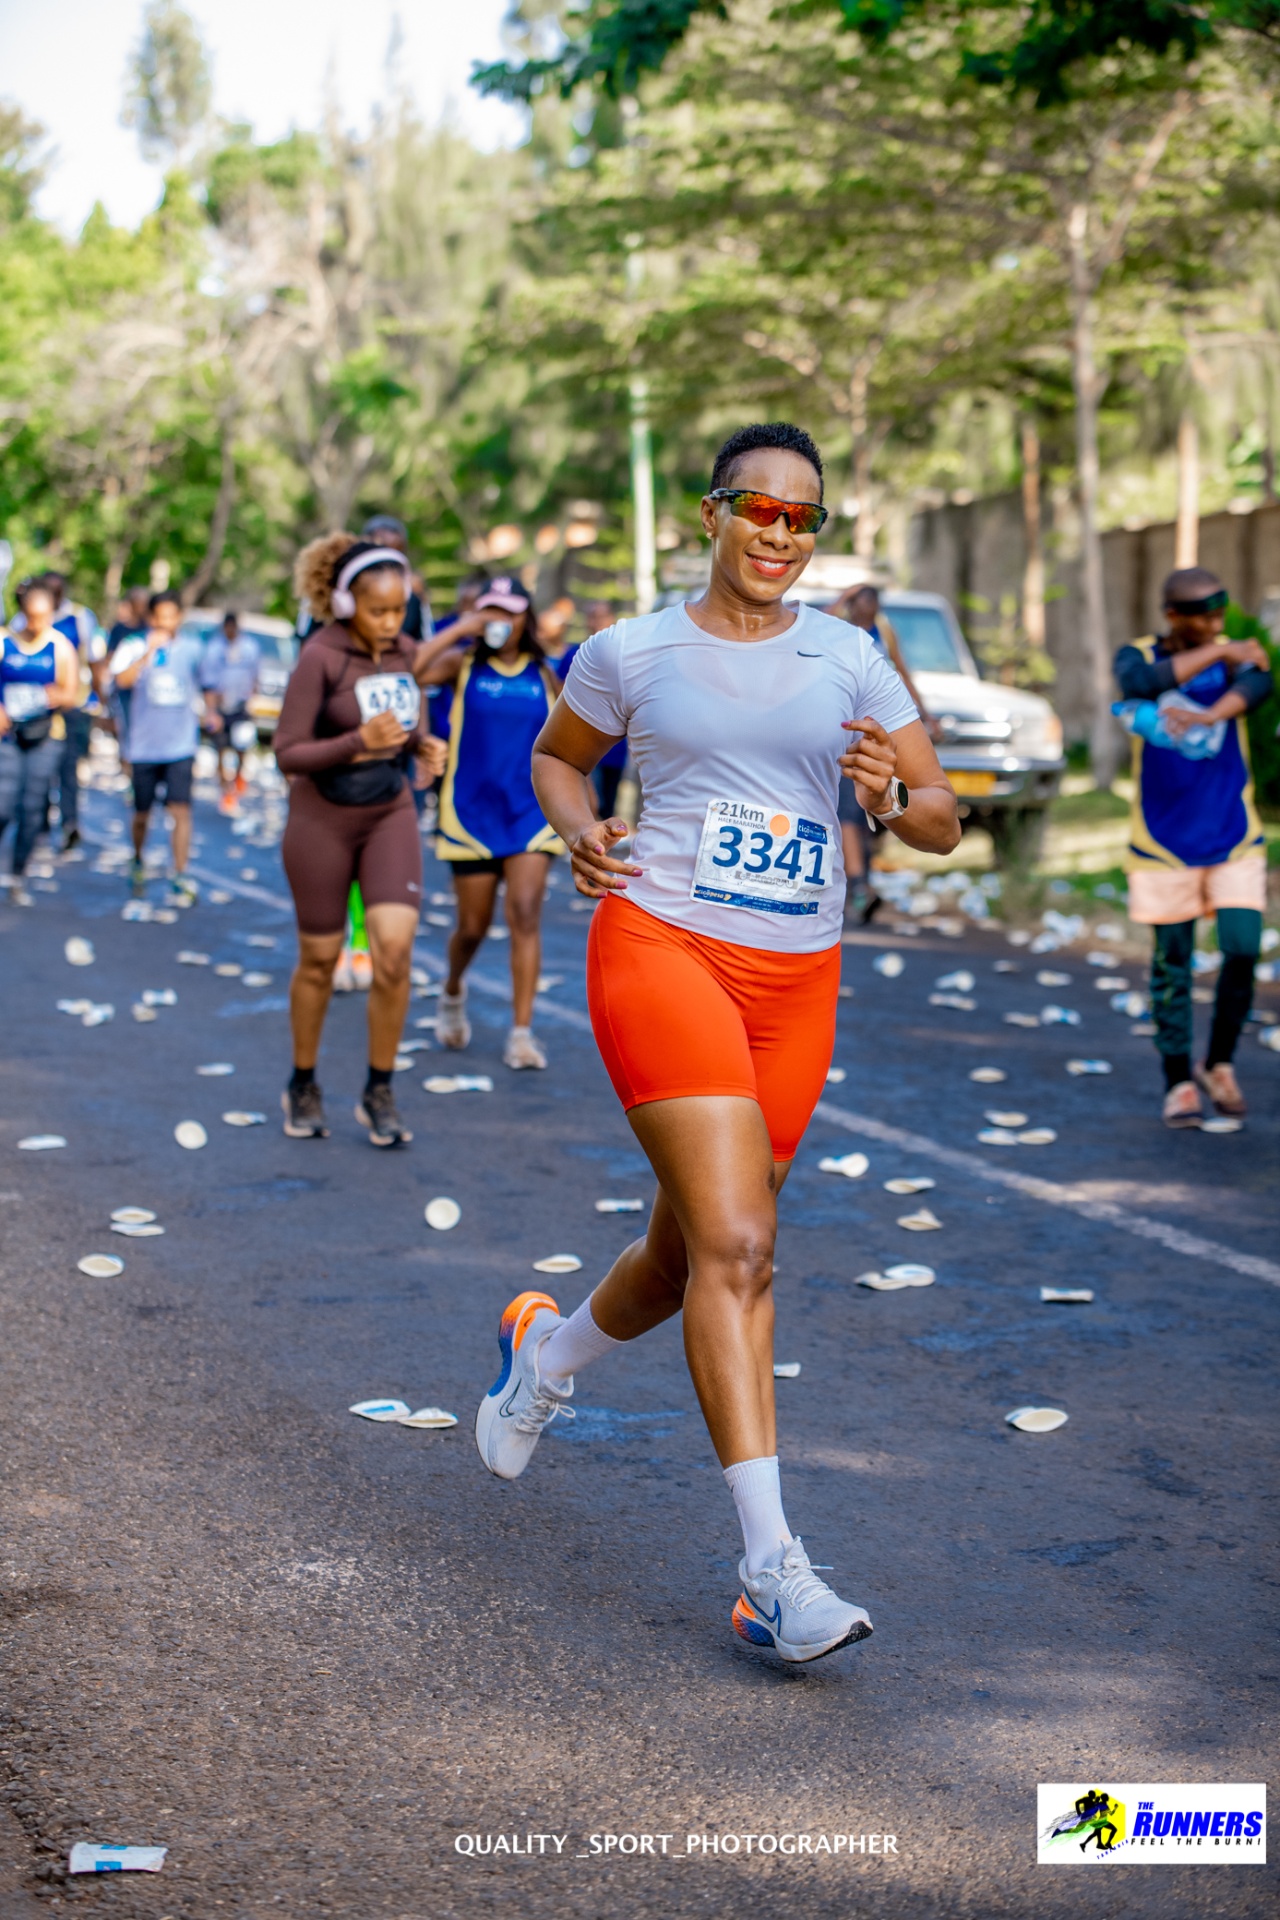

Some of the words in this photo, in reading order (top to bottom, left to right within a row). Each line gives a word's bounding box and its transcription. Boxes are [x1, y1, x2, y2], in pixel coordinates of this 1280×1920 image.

[717, 816, 732, 824] HALF
[733, 819, 766, 830] MARATHON
[719, 802, 765, 827] 21km
[712, 825, 825, 886] 3341
